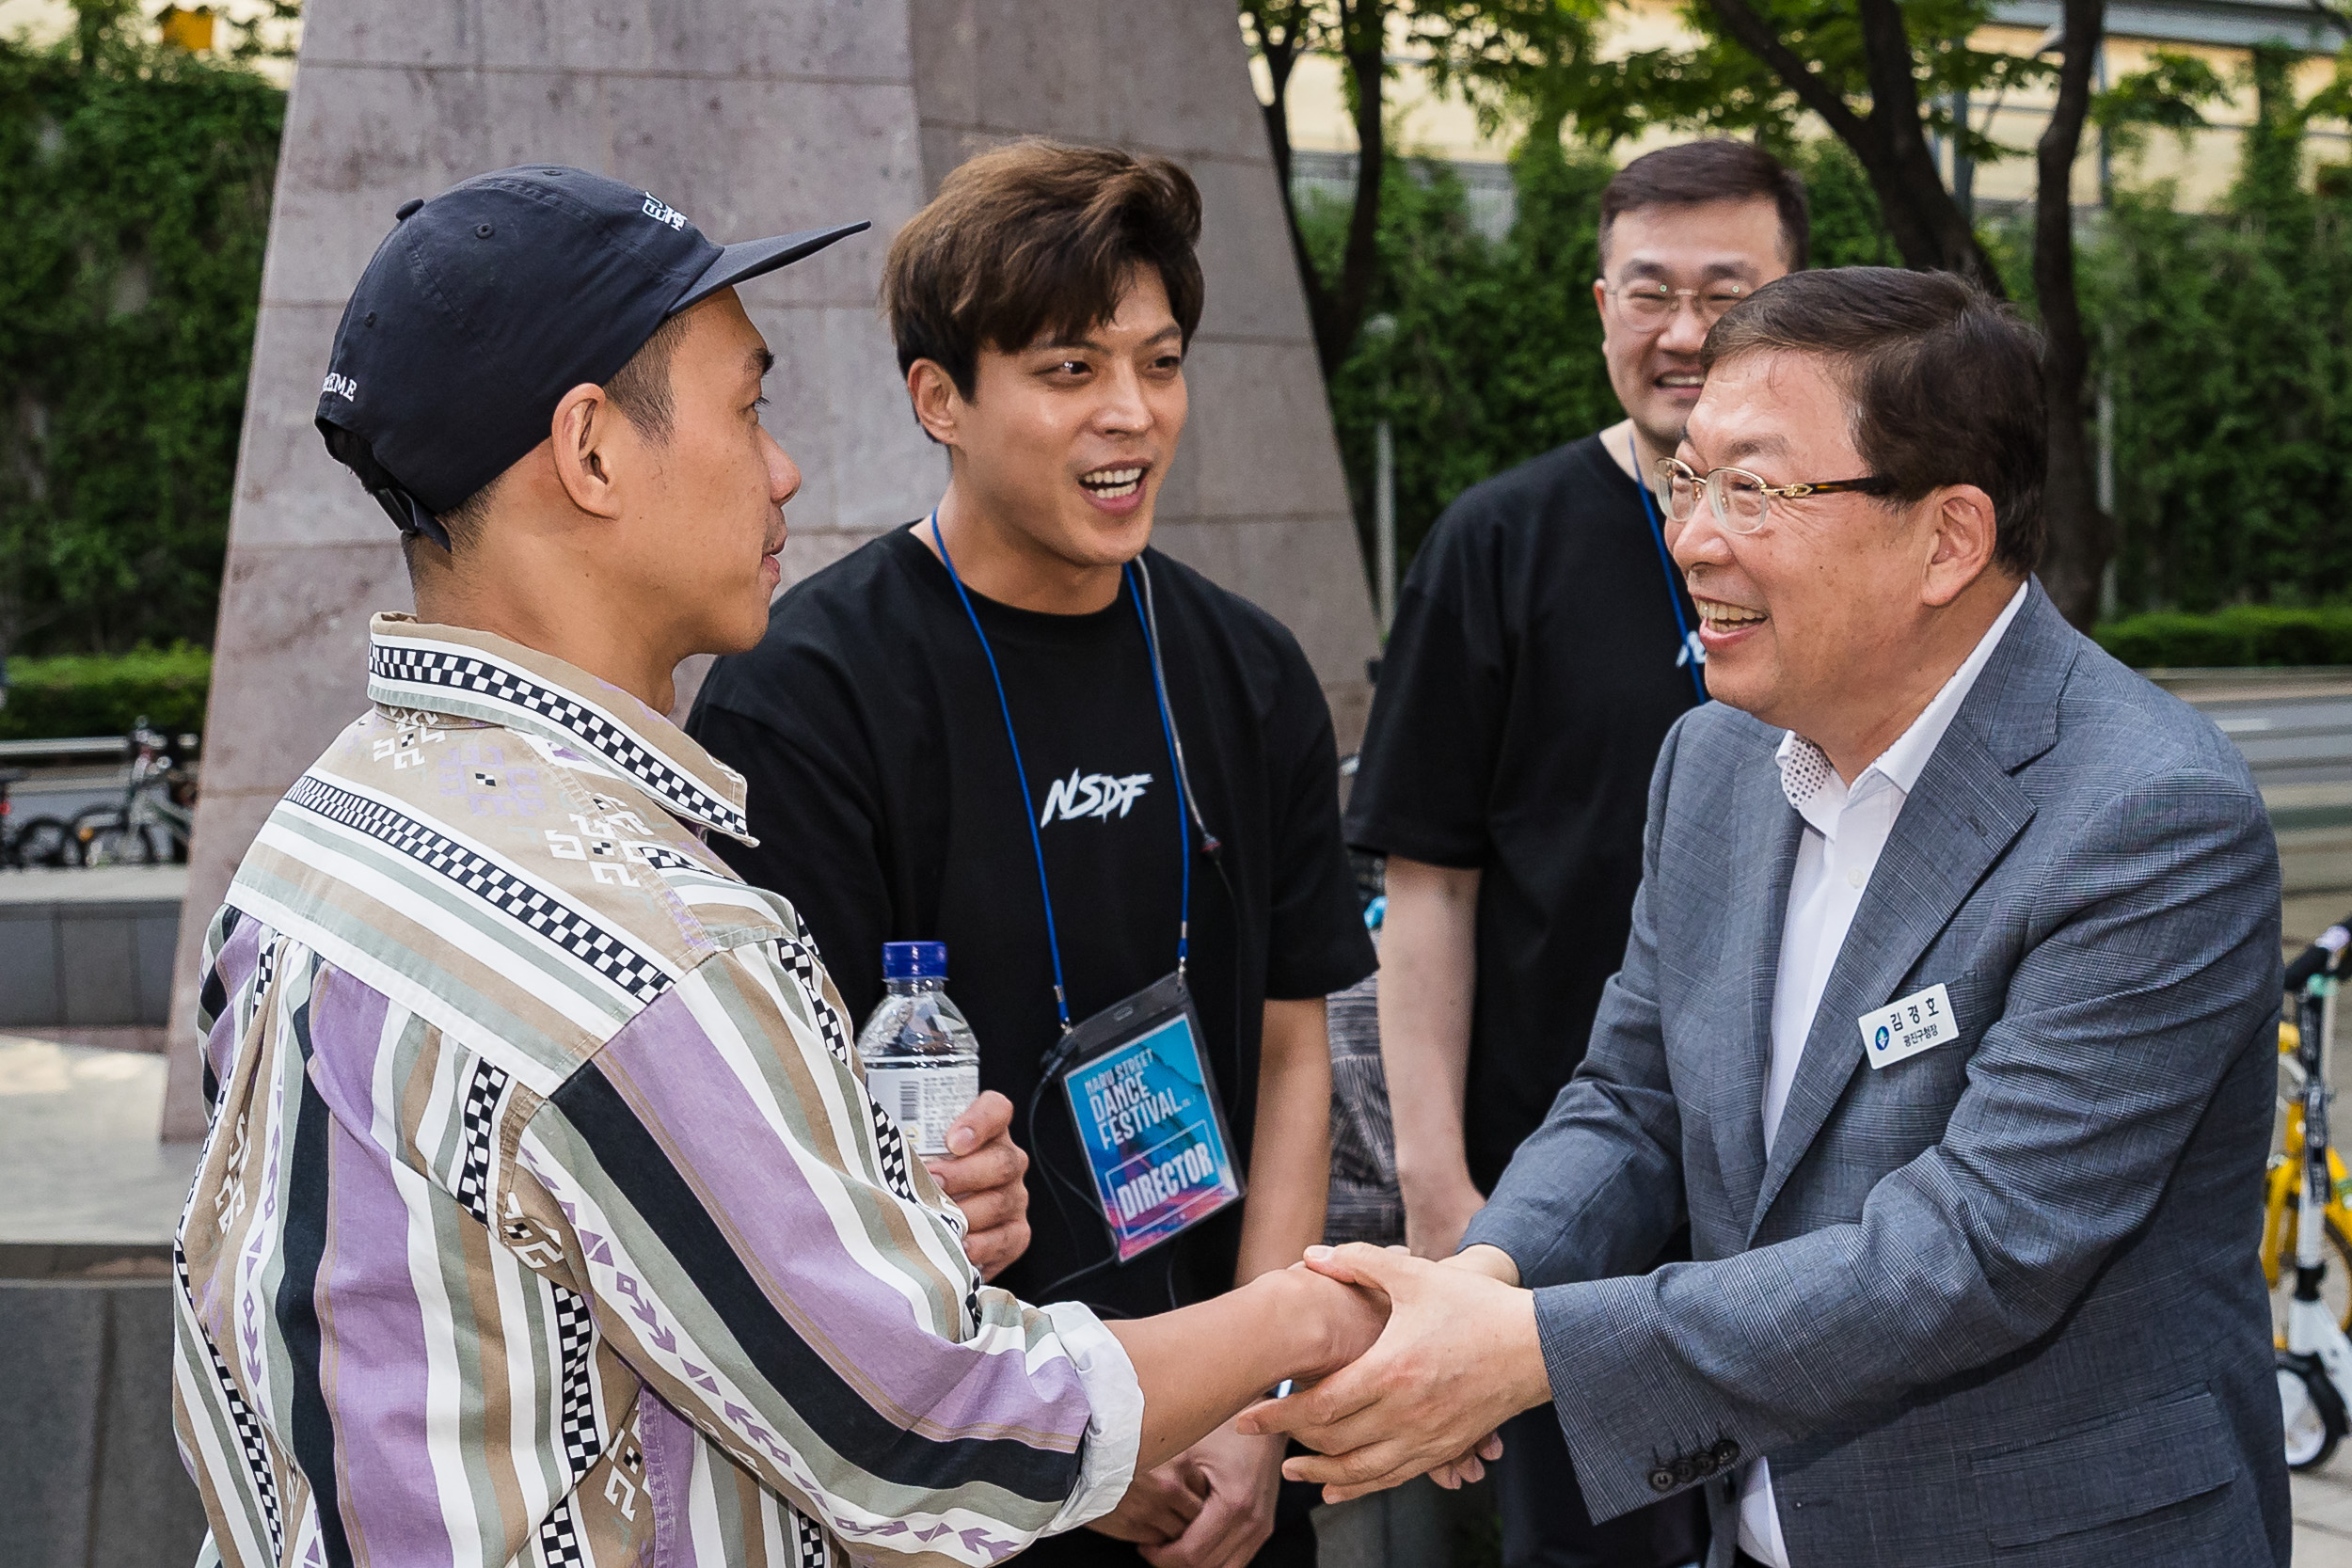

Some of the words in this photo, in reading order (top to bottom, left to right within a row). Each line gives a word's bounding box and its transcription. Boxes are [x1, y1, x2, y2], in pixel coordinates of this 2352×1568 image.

[1041, 768, 1153, 829] NSDF
[1890, 998, 1939, 1032] 김경호
[1903, 1023, 1938, 1047] 광진구청장
[1114, 1048, 1153, 1081] STREET
[1089, 1071, 1151, 1123] DANCE
[1097, 1087, 1183, 1150] FESTIVAL
[1117, 1142, 1214, 1222] DIRECTOR
